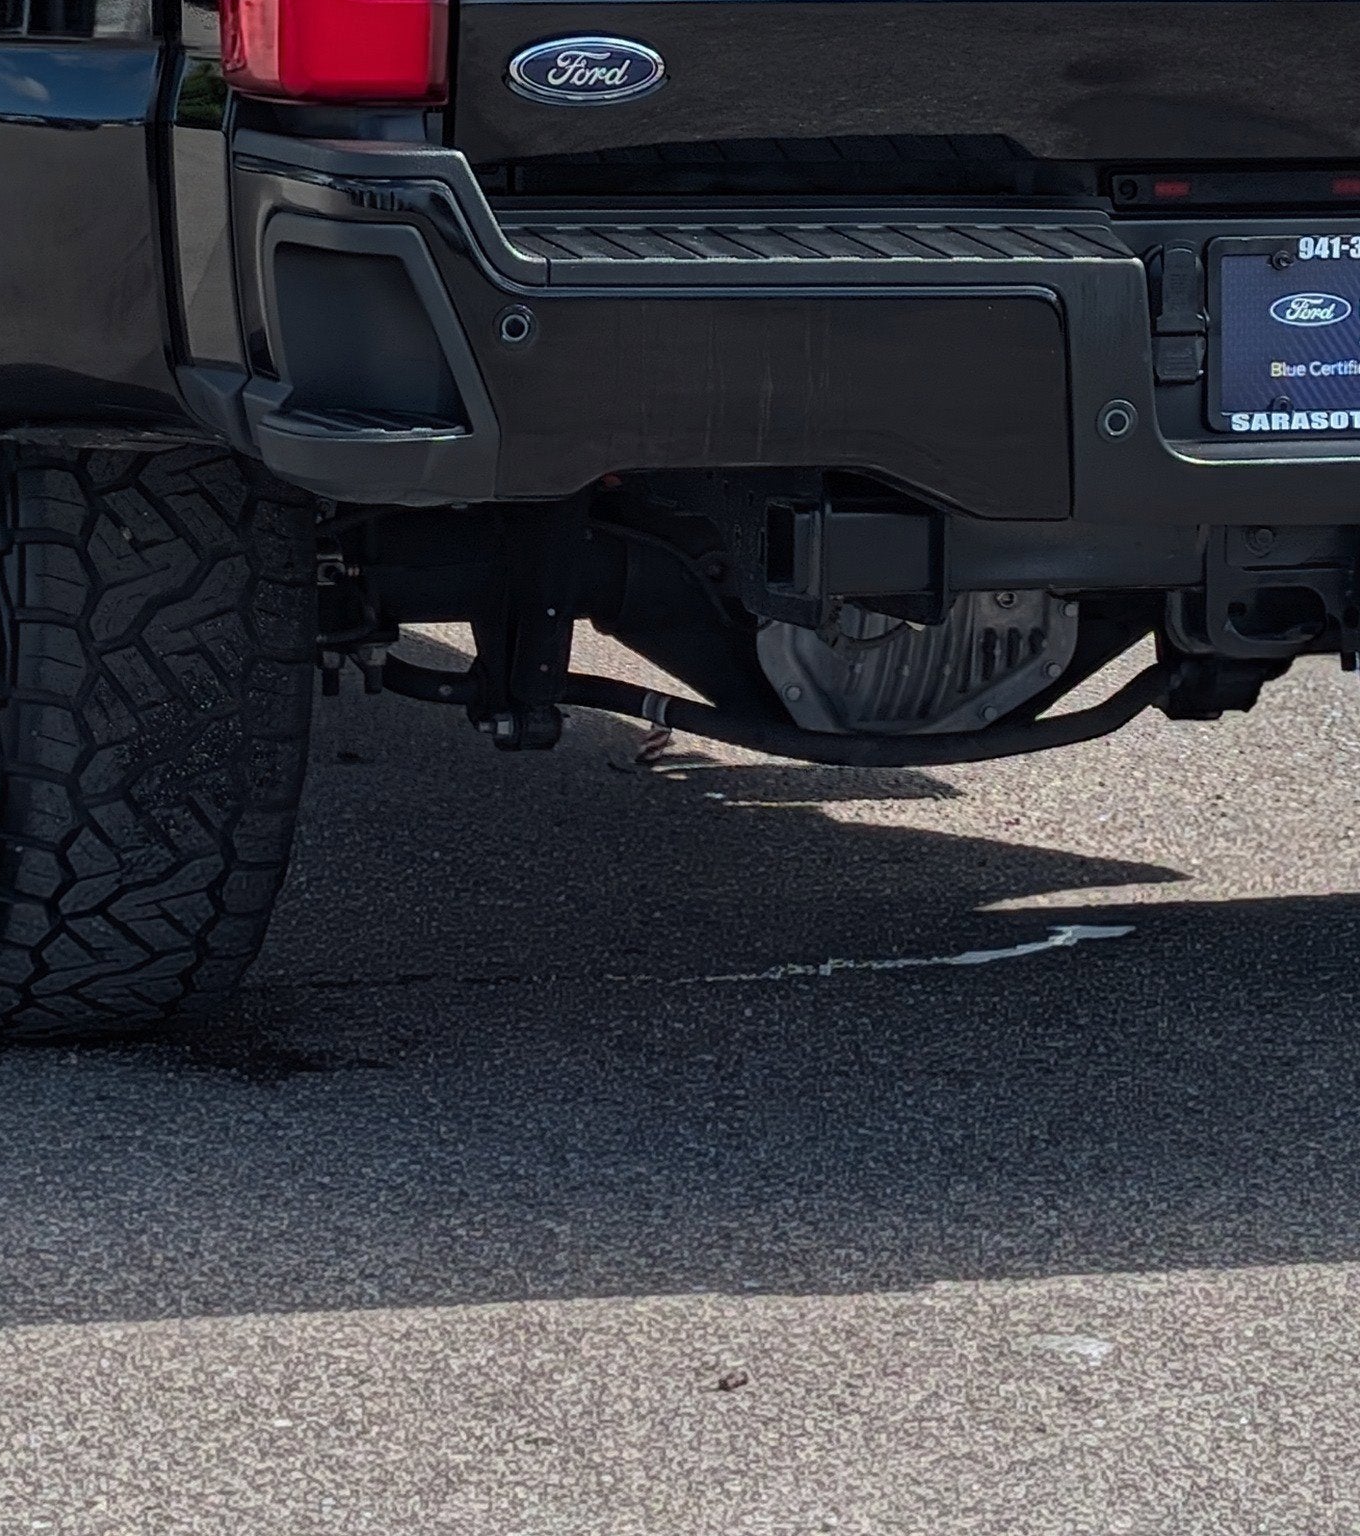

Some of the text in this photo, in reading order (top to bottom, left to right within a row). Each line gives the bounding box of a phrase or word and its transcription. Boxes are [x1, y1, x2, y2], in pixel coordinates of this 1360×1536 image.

[547, 49, 632, 86] Ford
[1285, 296, 1336, 321] Ford
[1270, 361, 1307, 378] Blue
